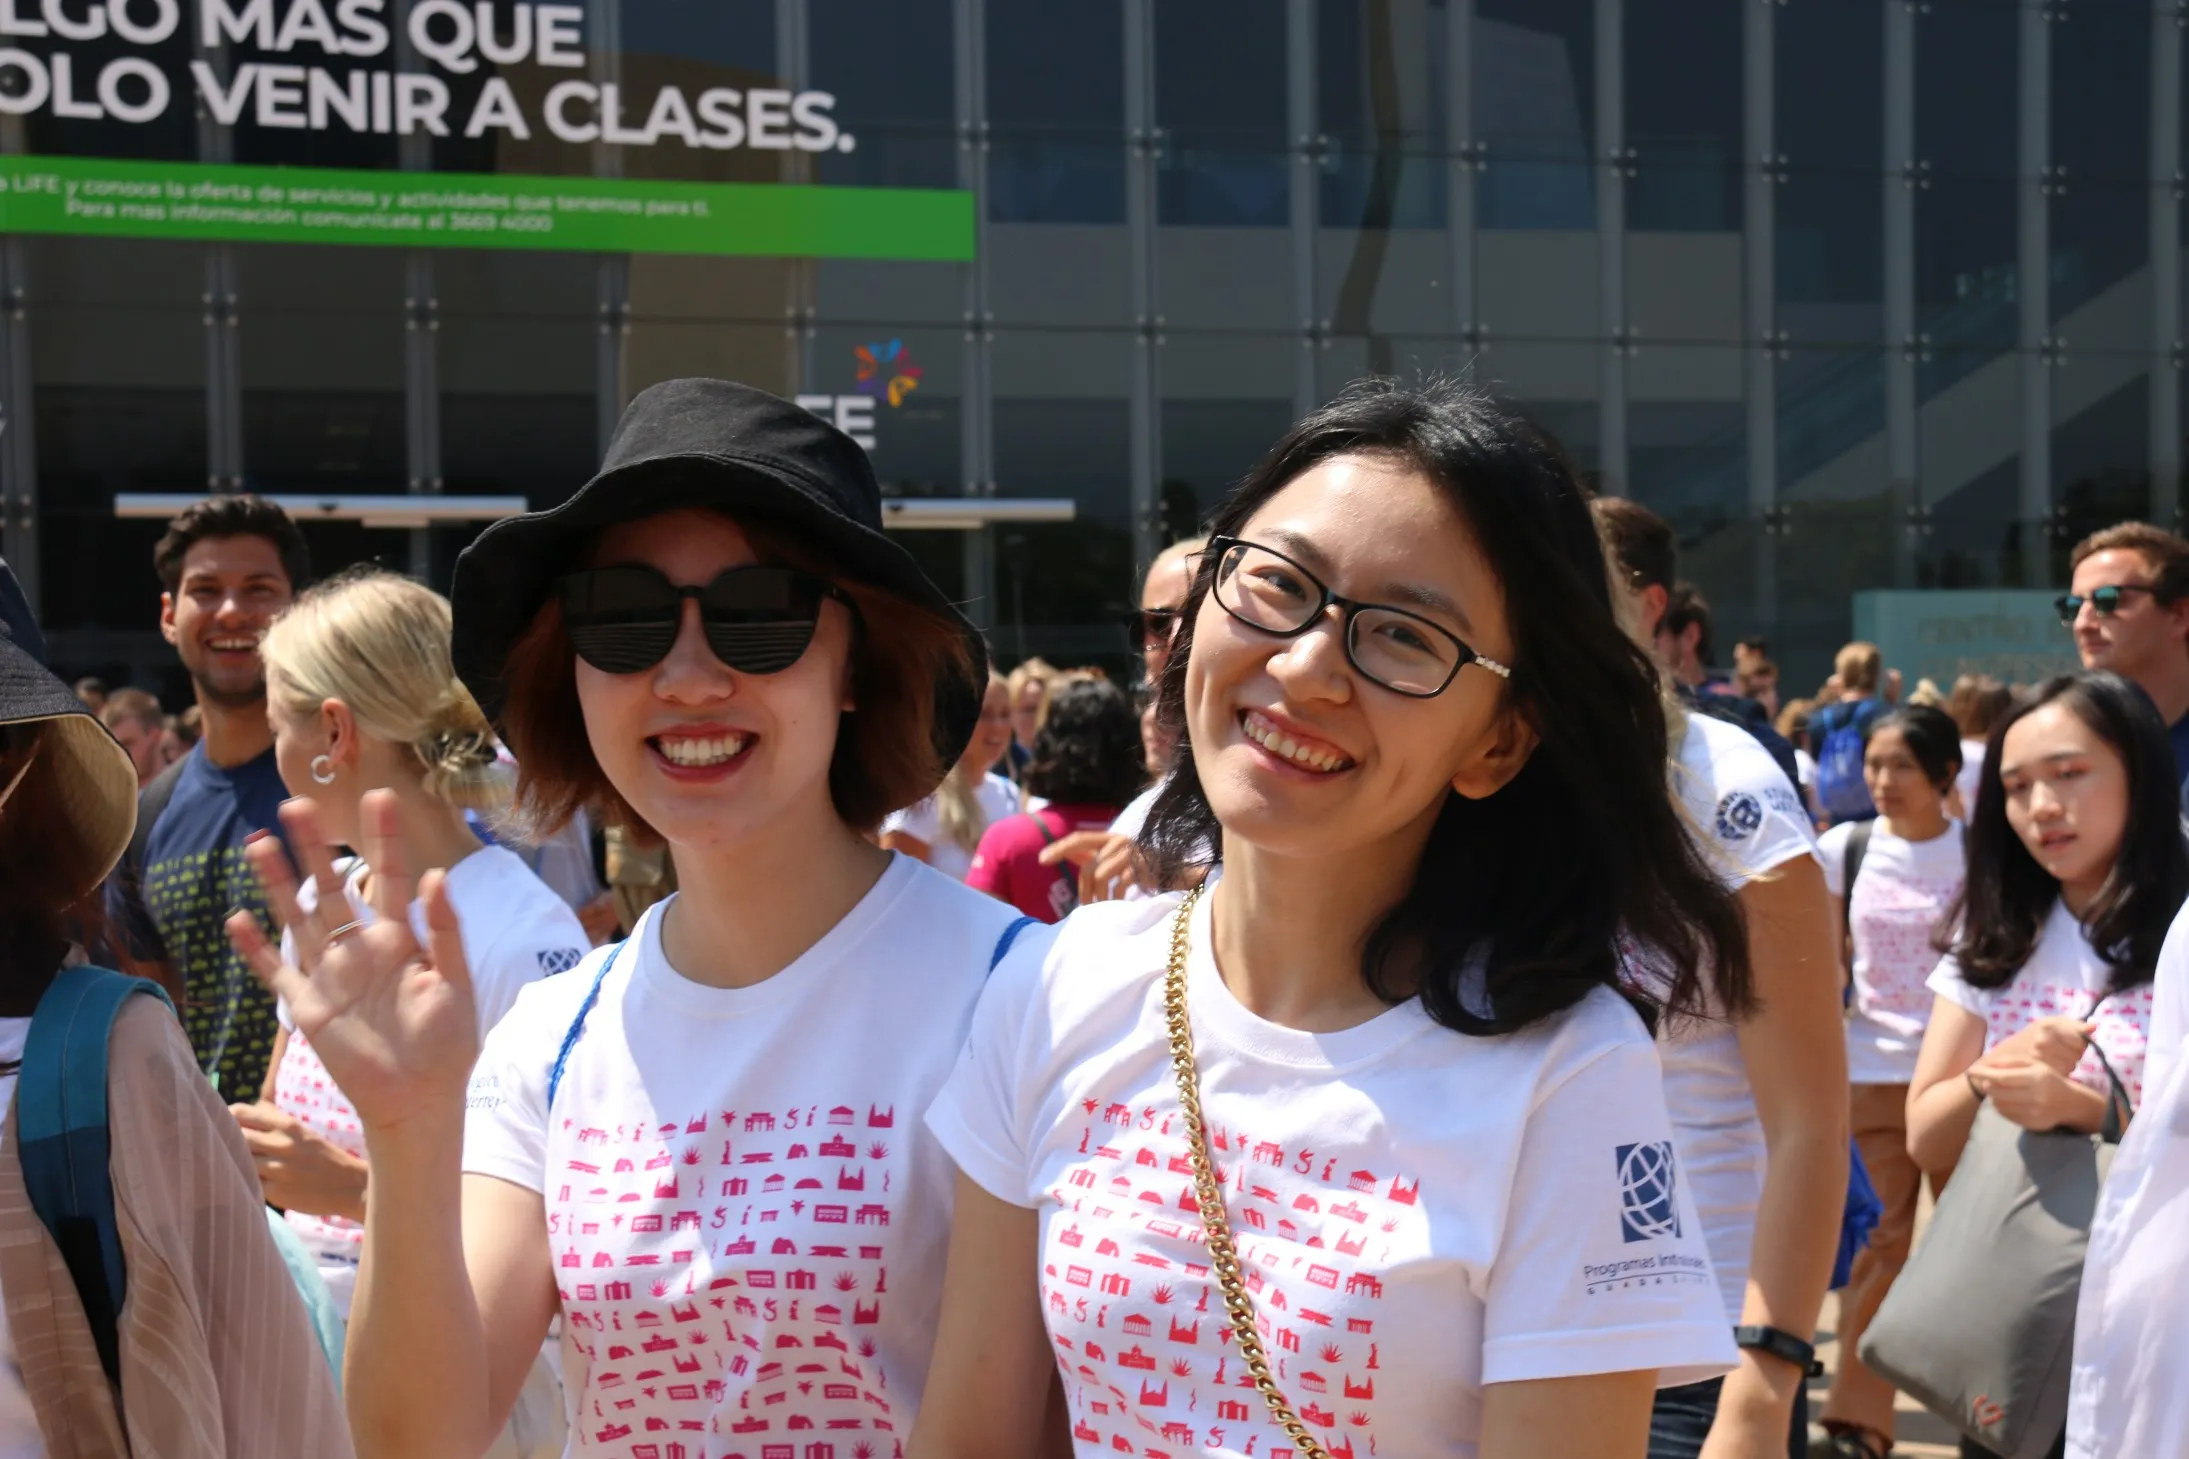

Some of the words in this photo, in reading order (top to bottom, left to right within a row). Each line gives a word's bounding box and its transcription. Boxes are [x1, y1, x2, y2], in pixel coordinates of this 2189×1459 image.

[408, 0, 586, 73] QUE
[0, 48, 170, 123] OLO
[190, 61, 450, 137] VENIR
[465, 77, 530, 140] A
[543, 80, 855, 153] CLASES.
[12, 173, 60, 194] LIFE
[65, 180, 80, 200] y
[82, 179, 162, 198] conoce
[165, 179, 186, 199] la
[188, 178, 252, 202] oferta
[256, 182, 285, 203] de
[286, 186, 376, 206] servicios
[378, 191, 394, 213] y
[396, 189, 510, 210] actividades
[513, 193, 554, 213] que
[556, 193, 643, 214] tenemos
[645, 199, 690, 218] para
[65, 197, 115, 218] Para
[426, 210, 446, 230] al
[1584, 1256, 1656, 1277] Programas
